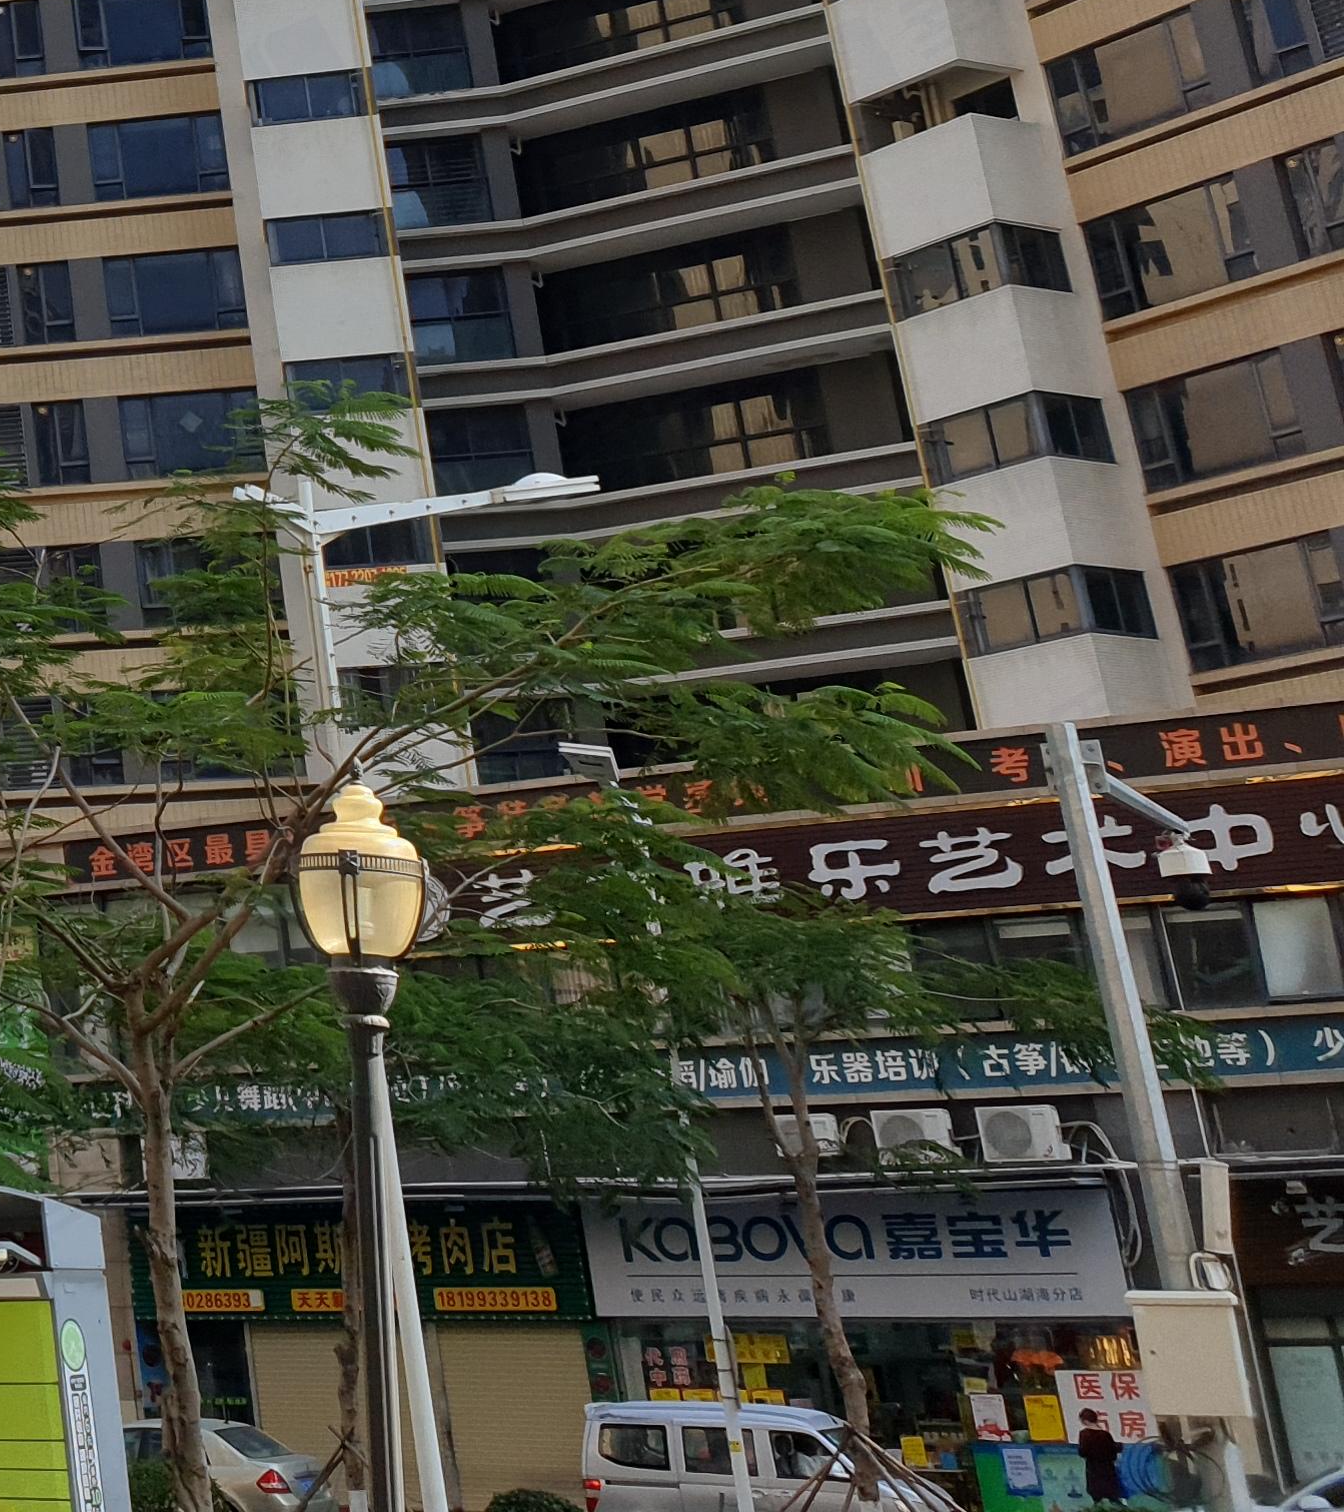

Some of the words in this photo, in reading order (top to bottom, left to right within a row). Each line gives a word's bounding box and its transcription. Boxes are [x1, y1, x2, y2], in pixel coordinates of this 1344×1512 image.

[881, 1209, 1072, 1261] 嘉宝华
[182, 1291, 251, 1309] 0286393
[437, 1290, 553, 1310] 18199339138
[1073, 1372, 1141, 1400] 医保
